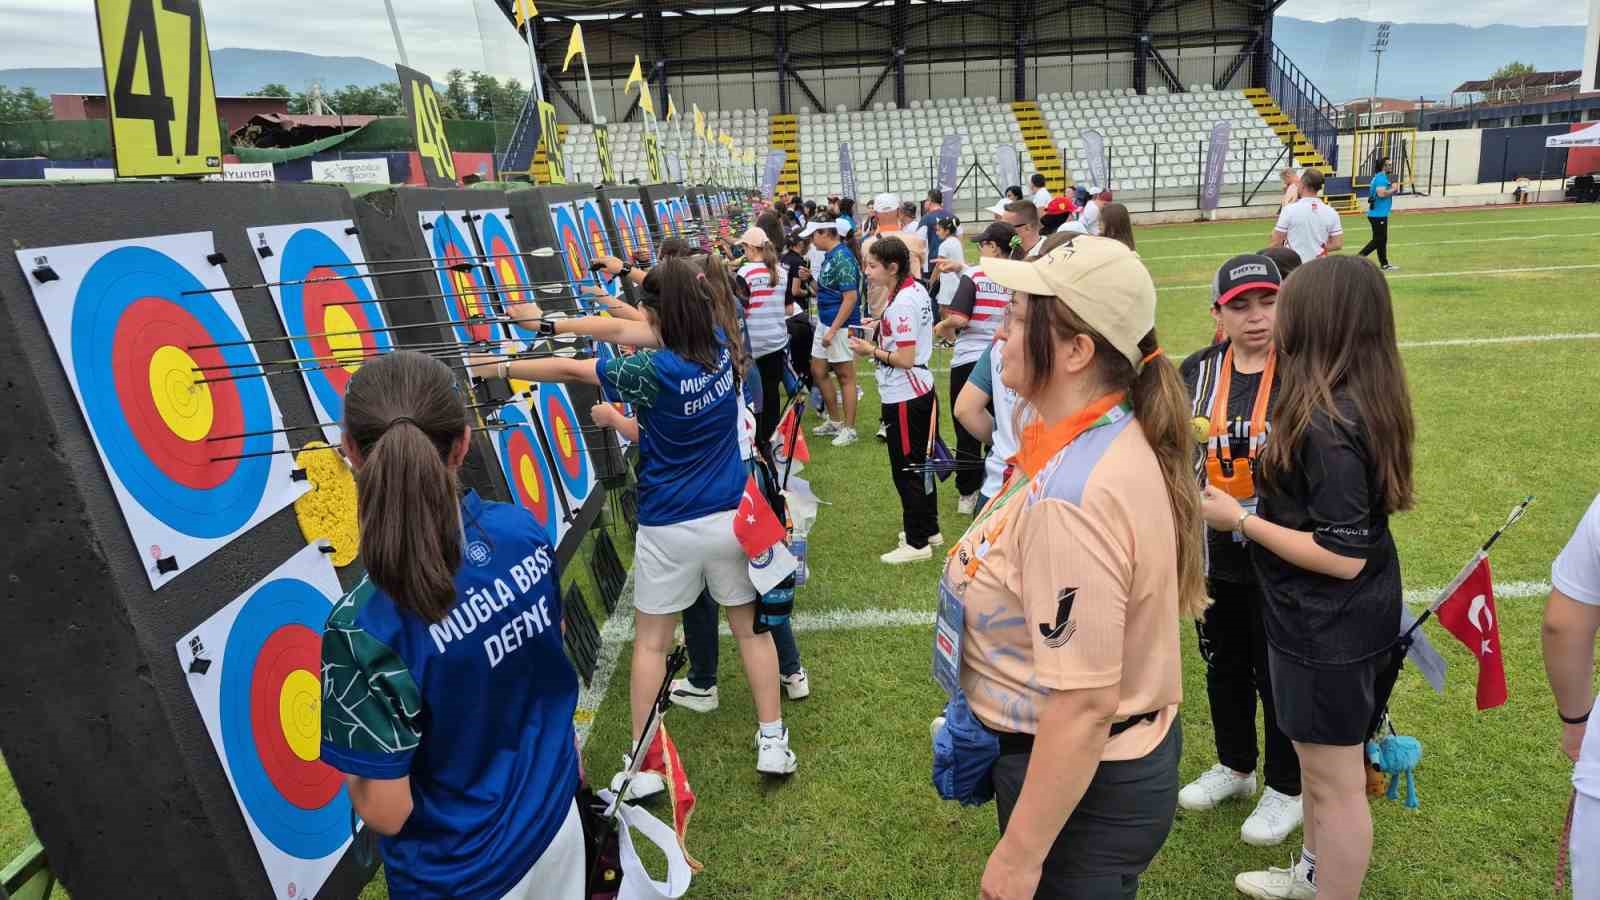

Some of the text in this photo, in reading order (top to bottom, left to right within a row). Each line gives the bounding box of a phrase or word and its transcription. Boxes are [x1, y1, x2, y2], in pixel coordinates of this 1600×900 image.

[114, 0, 203, 157] 47
[411, 79, 457, 181] 48
[428, 578, 516, 654] MUĞLA
